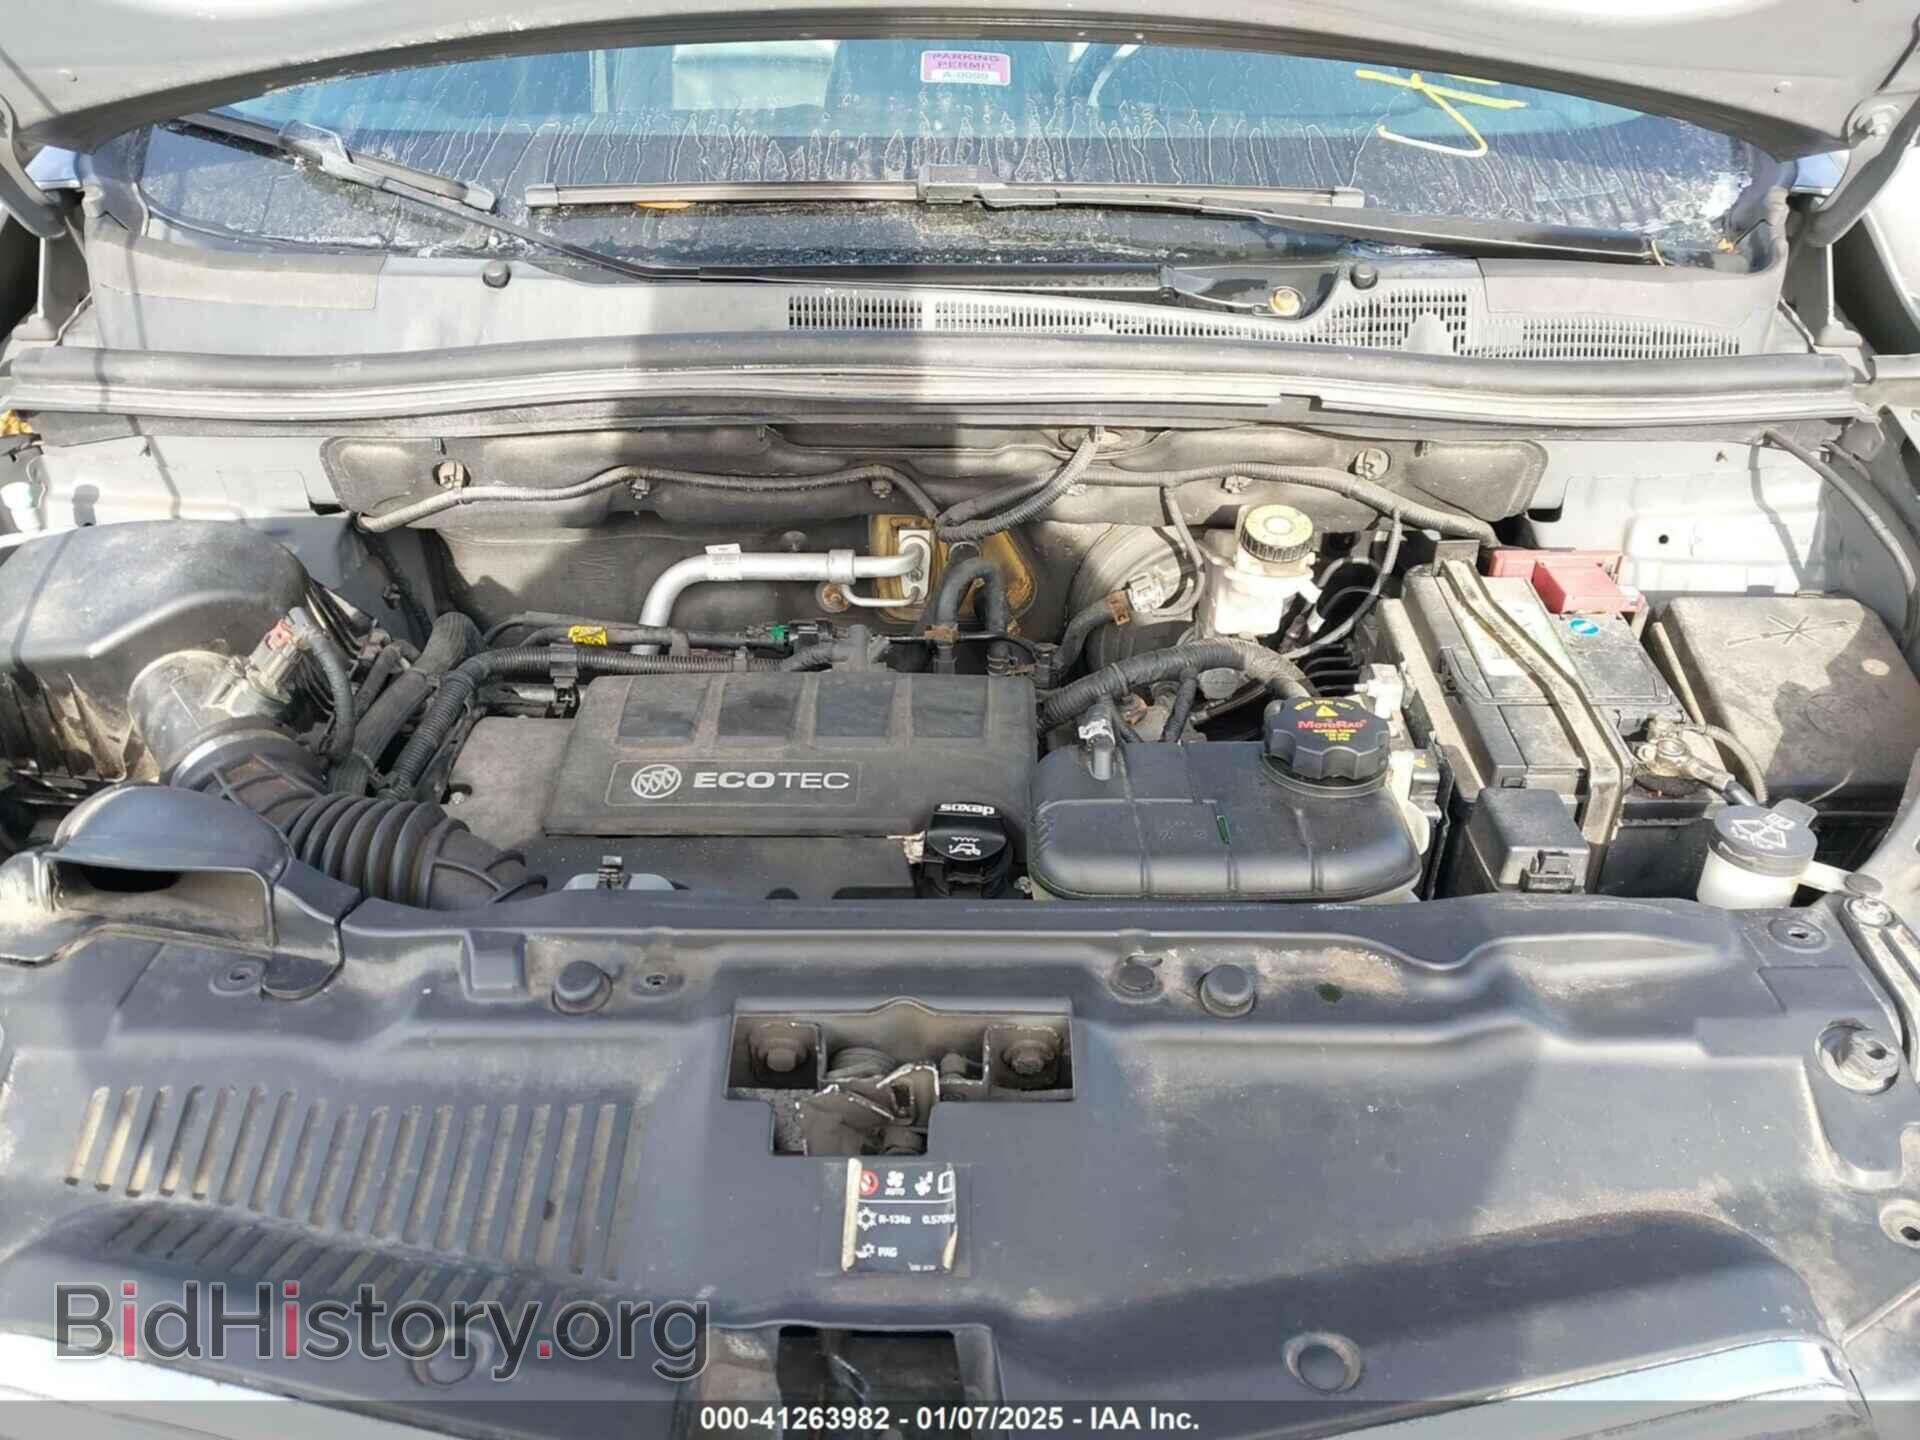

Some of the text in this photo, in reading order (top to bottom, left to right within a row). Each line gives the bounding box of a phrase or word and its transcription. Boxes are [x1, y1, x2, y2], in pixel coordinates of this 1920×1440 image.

[933, 53, 1000, 62] PARKING
[937, 61, 994, 71] PERMIT
[693, 771, 850, 790] ECOTEC
[938, 803, 995, 816] dexos
